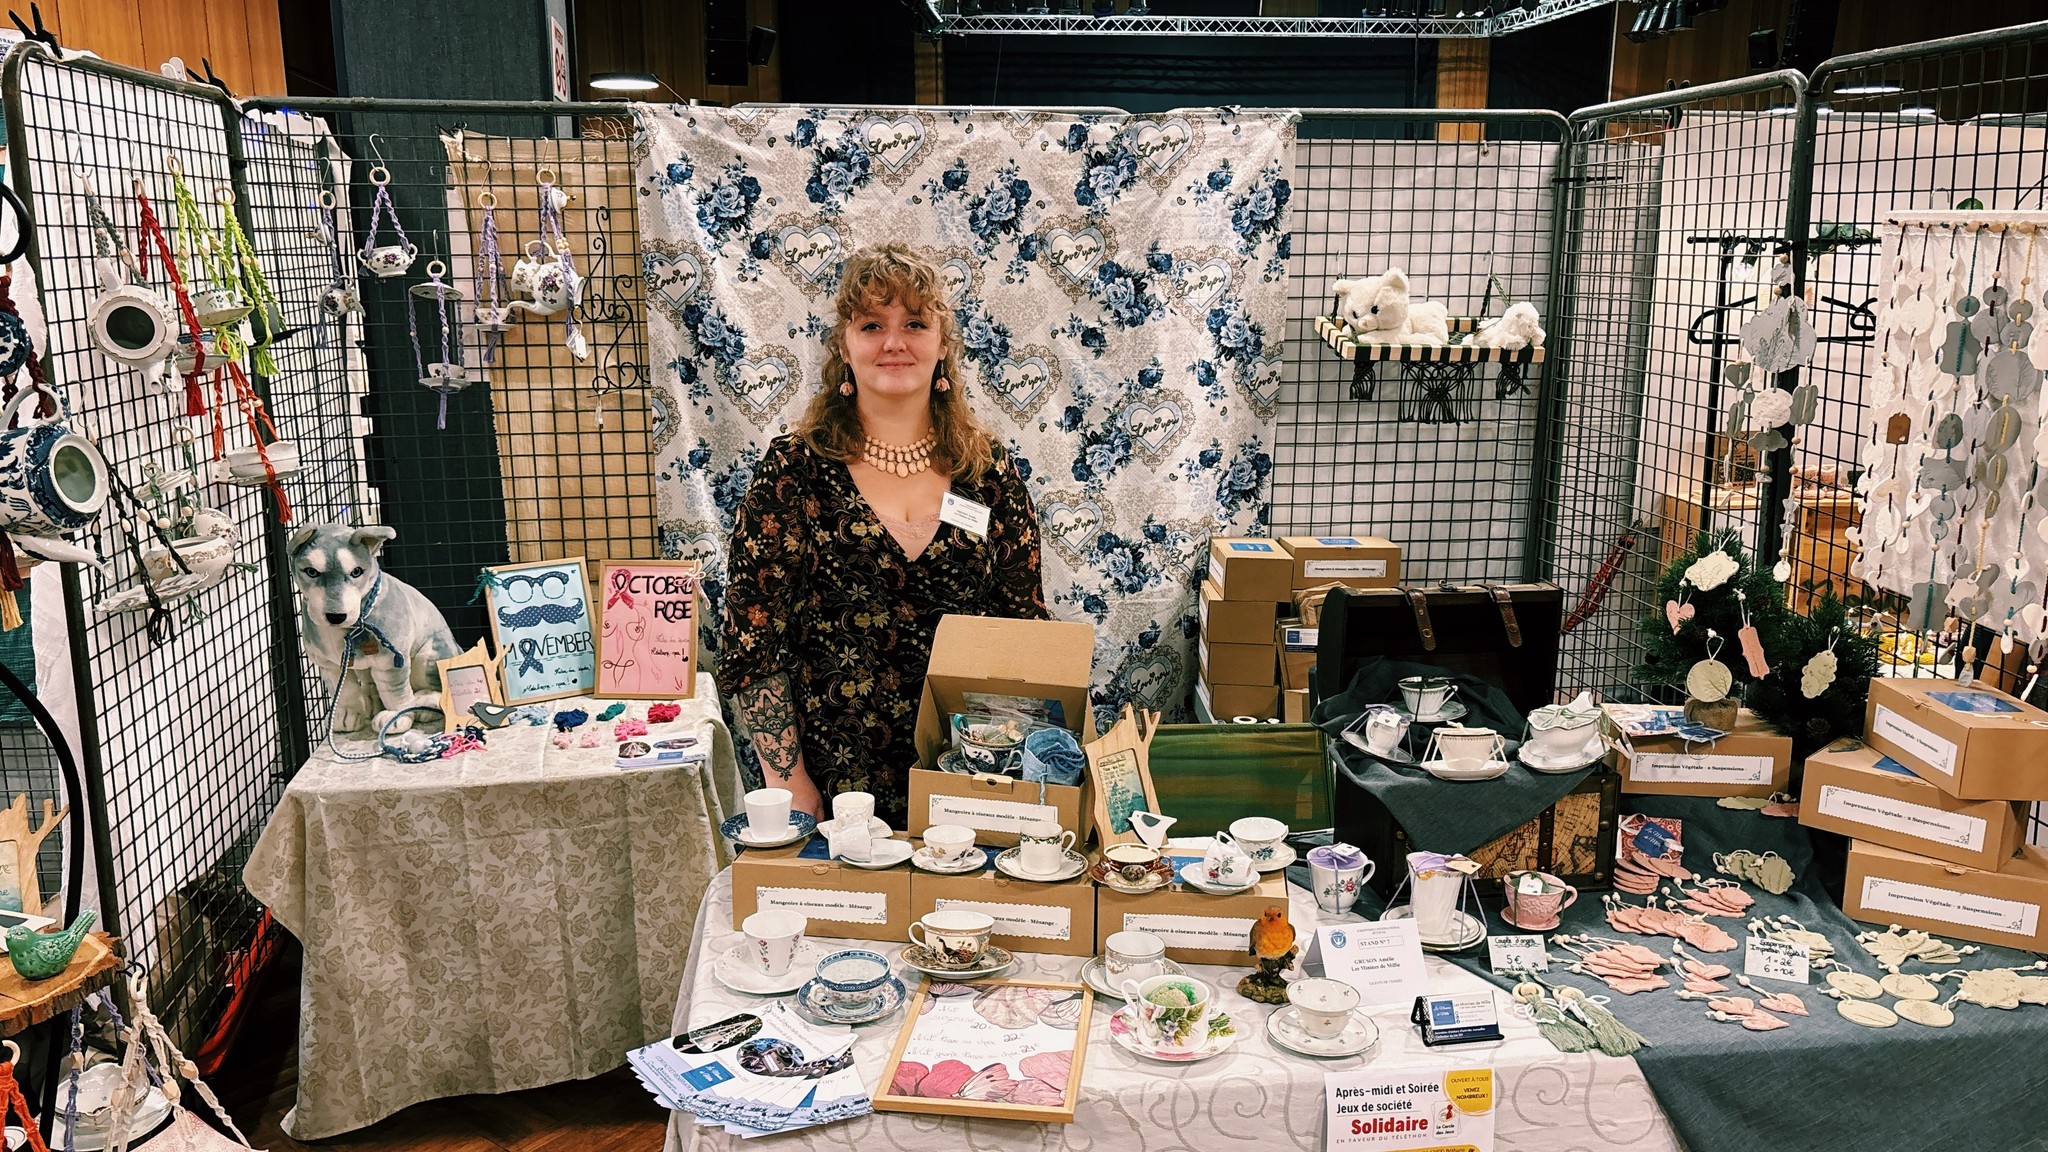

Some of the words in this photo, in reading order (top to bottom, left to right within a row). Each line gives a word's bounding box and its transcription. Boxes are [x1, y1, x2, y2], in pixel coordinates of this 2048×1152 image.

[869, 137, 893, 157] Love
[899, 132, 922, 153] you
[1137, 140, 1162, 160] Love
[1167, 136, 1189, 156] you
[785, 245, 810, 265] Love
[814, 242, 838, 262] you
[1051, 248, 1075, 268] Love
[1078, 245, 1101, 265] you
[649, 272, 673, 292] Love
[676, 268, 698, 288] you
[1176, 280, 1199, 299] Love
[1204, 275, 1227, 295] you
[734, 376, 760, 397] Love
[765, 373, 787, 392] you
[999, 375, 1022, 395] Love
[1026, 373, 1048, 391] you
[1249, 373, 1270, 391] Love
[1131, 421, 1155, 440] Love
[1157, 416, 1180, 436] you
[1051, 519, 1076, 539] Love
[1078, 515, 1100, 535] you
[654, 600, 692, 623] ROSE
[1130, 676, 1150, 696] Love
[1151, 669, 1170, 688] you
[944, 808, 971, 816] Mangeoire
[1843, 800, 1877, 813] Impression
[1878, 808, 1903, 819] Végétale
[1912, 817, 1951, 830] Suspensions
[770, 899, 798, 907] Mangeoire
[1888, 892, 1924, 903] Impression
[1925, 898, 1952, 908] Végétale
[1962, 905, 2002, 917] Suspensions
[1006, 916, 1026, 924] modèle
[1031, 918, 1054, 926] Mésange
[1139, 926, 1170, 934] Mangeoire
[1764, 965, 1770, 973] 6
[1780, 958, 1793, 967] 2€
[1335, 1084, 1393, 1100] Après-midi
[1395, 1084, 1406, 1095] et
[1408, 1082, 1440, 1093] Soirée
[1336, 1102, 1359, 1114] Jeux
[1361, 1101, 1374, 1112] de
[1376, 1099, 1413, 1111] société
[1351, 1116, 1429, 1135] Solidaire
